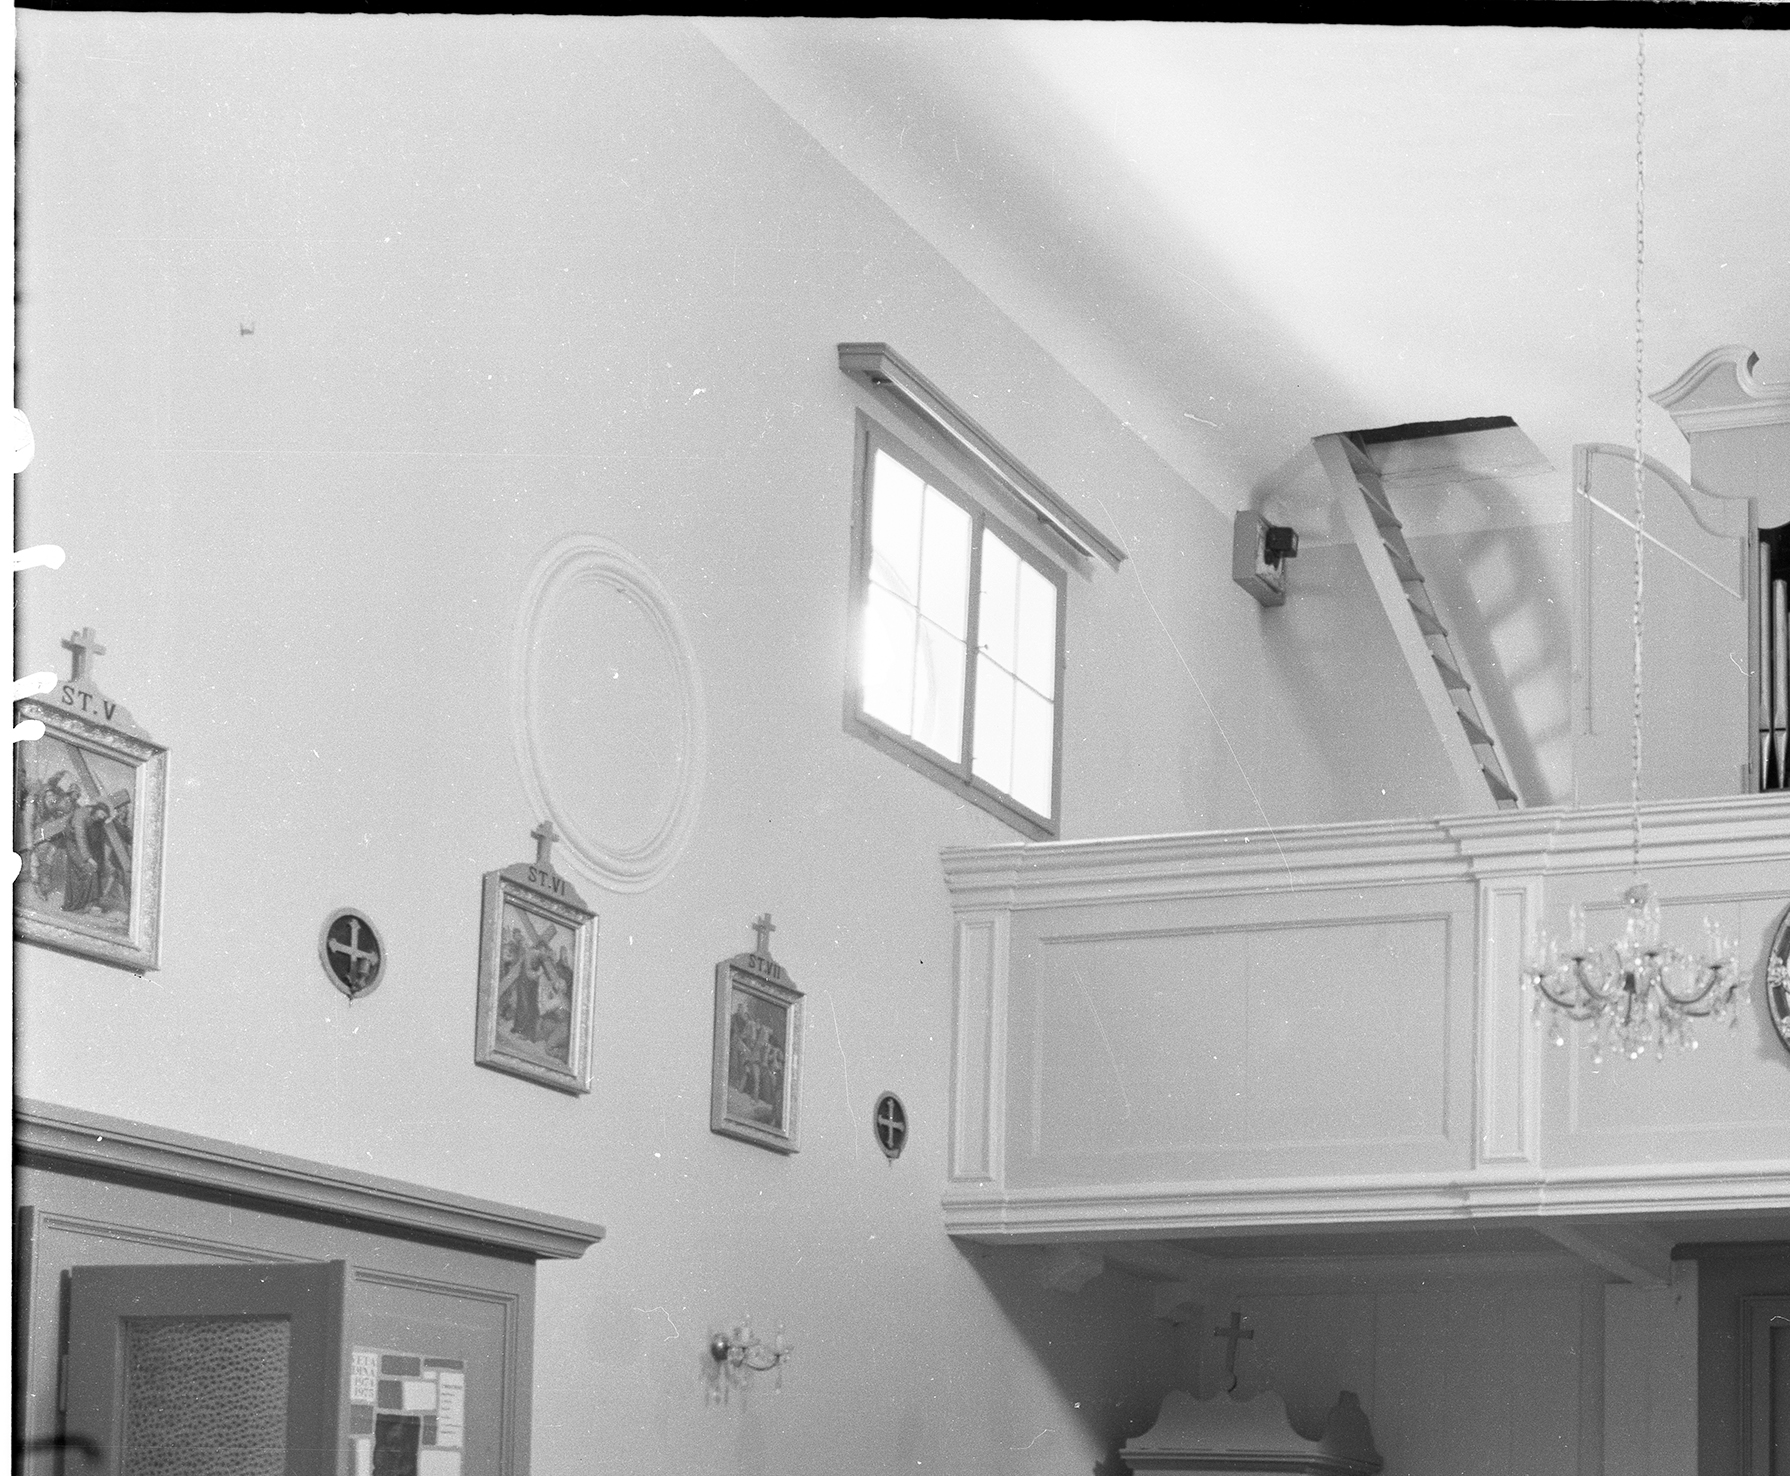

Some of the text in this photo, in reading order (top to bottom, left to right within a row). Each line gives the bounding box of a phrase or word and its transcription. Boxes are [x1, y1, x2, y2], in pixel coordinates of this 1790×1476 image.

[61, 684, 116, 721] ST.V
[527, 865, 566, 896] ST.VI
[354, 1387, 375, 1398] 1975
